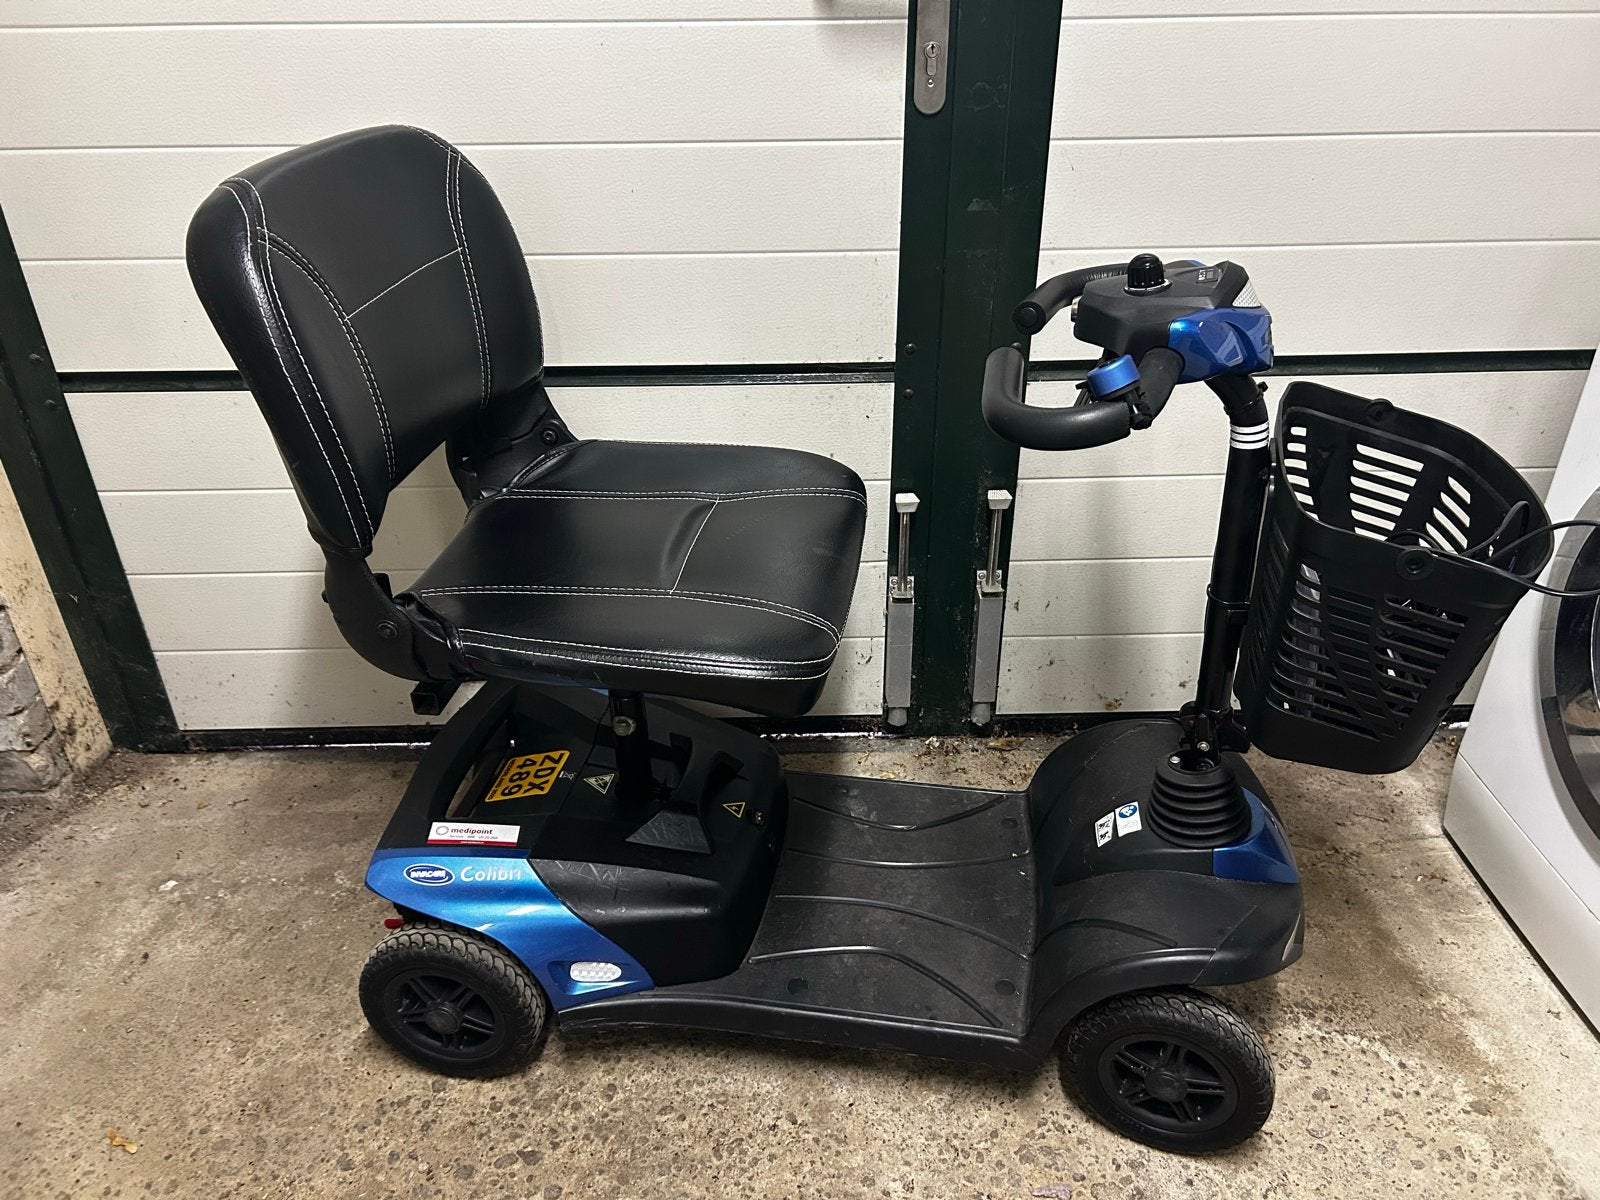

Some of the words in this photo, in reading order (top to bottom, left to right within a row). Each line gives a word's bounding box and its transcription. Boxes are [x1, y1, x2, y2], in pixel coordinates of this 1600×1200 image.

[501, 758, 537, 796] 489
[523, 752, 565, 794] ZDX
[450, 827, 493, 835] medipoint
[460, 866, 523, 882] Colibri
